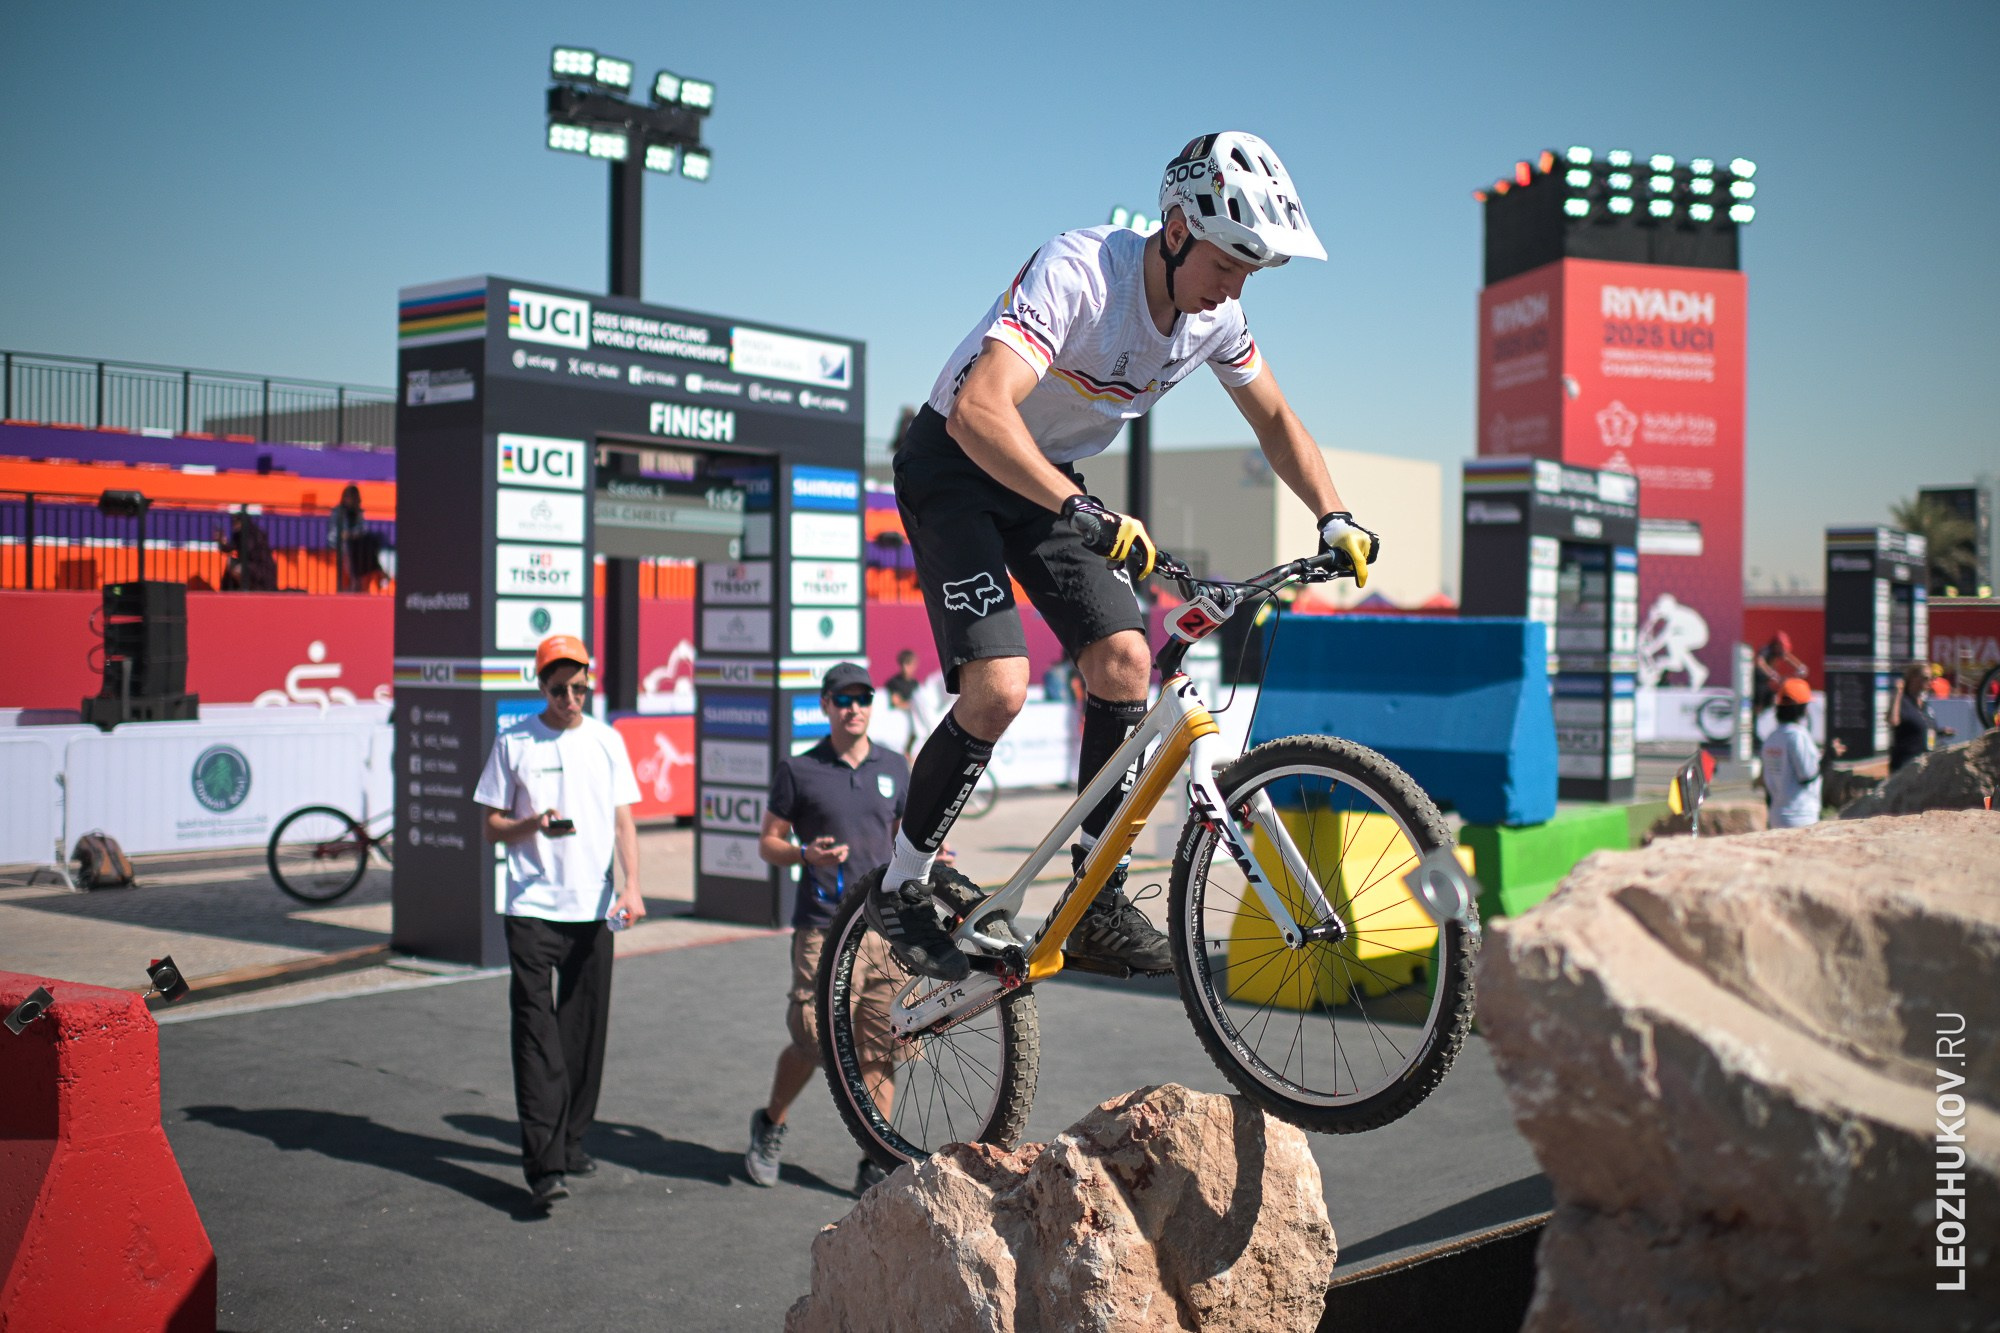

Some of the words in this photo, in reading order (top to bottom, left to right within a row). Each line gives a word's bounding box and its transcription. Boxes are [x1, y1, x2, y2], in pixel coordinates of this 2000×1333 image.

[1166, 162, 1206, 186] POC
[1602, 285, 1715, 325] RIYADH
[525, 303, 580, 337] UCI
[593, 312, 619, 327] 2025
[620, 315, 658, 334] URBAN
[660, 323, 708, 343] CYCLING
[593, 331, 636, 348] WORLD
[637, 337, 728, 363] CHAMPIONSHIPS
[1671, 328, 1715, 350] UCI
[650, 403, 734, 442] FINISH
[517, 447, 574, 478] UCI
[511, 568, 571, 584] TISSOT
[713, 581, 761, 594] TISSOT
[803, 582, 848, 594] TISSOT
[423, 665, 450, 682] UCI
[721, 666, 749, 681] UCI
[715, 797, 760, 823] UCI
[924, 783, 973, 848] hebo
